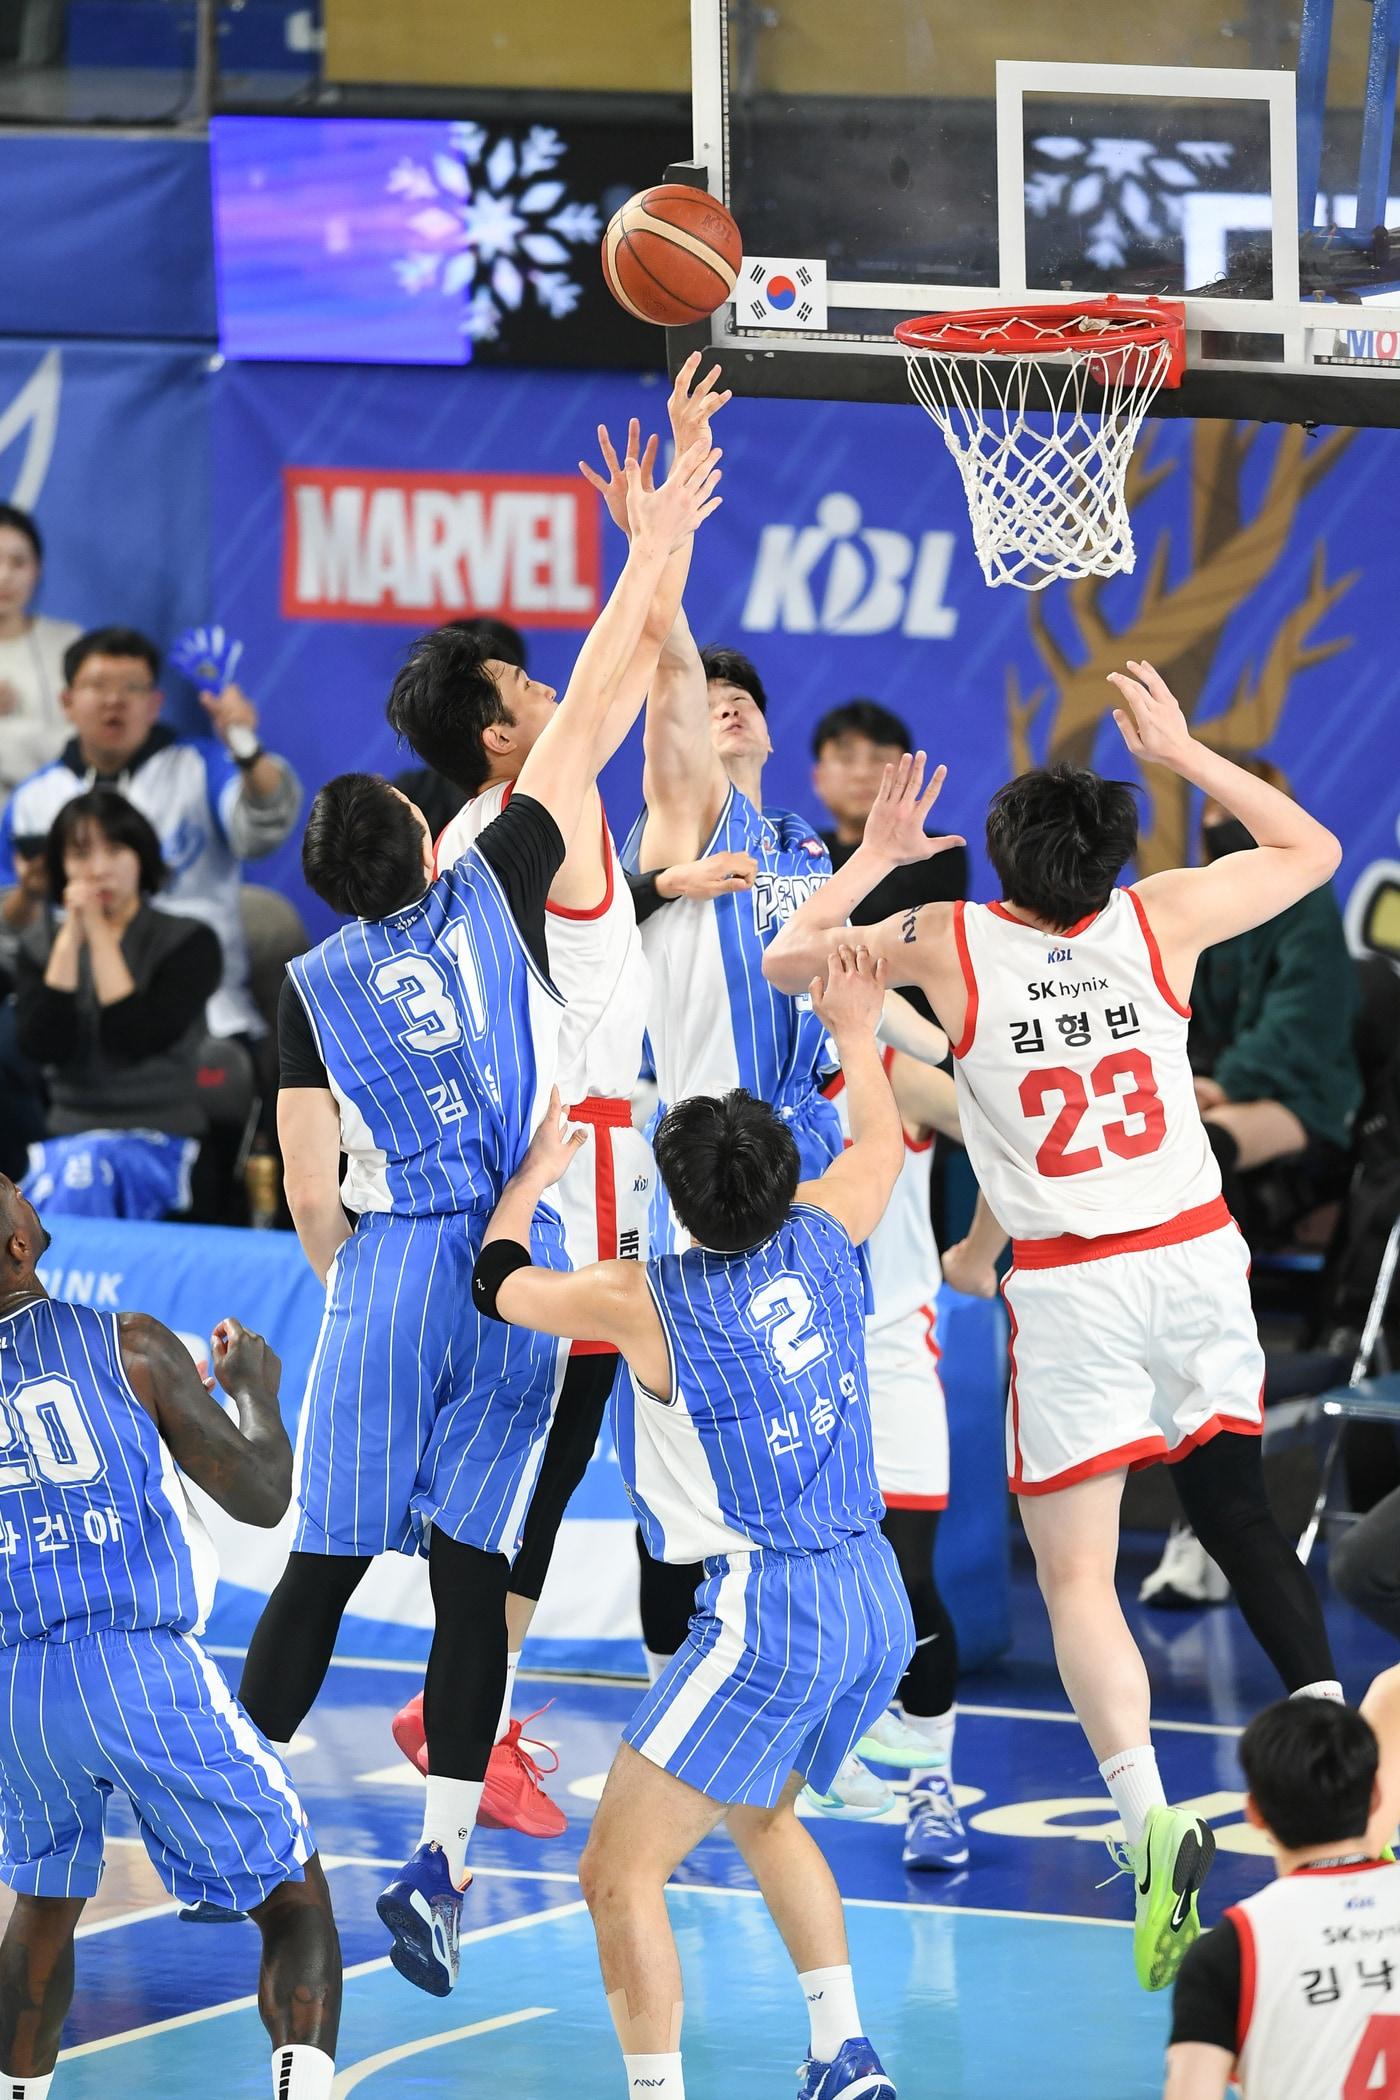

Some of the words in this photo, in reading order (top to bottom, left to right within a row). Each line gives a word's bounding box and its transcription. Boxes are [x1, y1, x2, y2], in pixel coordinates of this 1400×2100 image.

[296, 484, 594, 612] MARVEL
[740, 491, 958, 639] KBL
[367, 914, 489, 1059] 31
[1027, 979, 1058, 1002] SK
[1059, 977, 1110, 999] hynix
[1018, 1048, 1168, 1178] 23
[746, 1269, 834, 1385] 2
